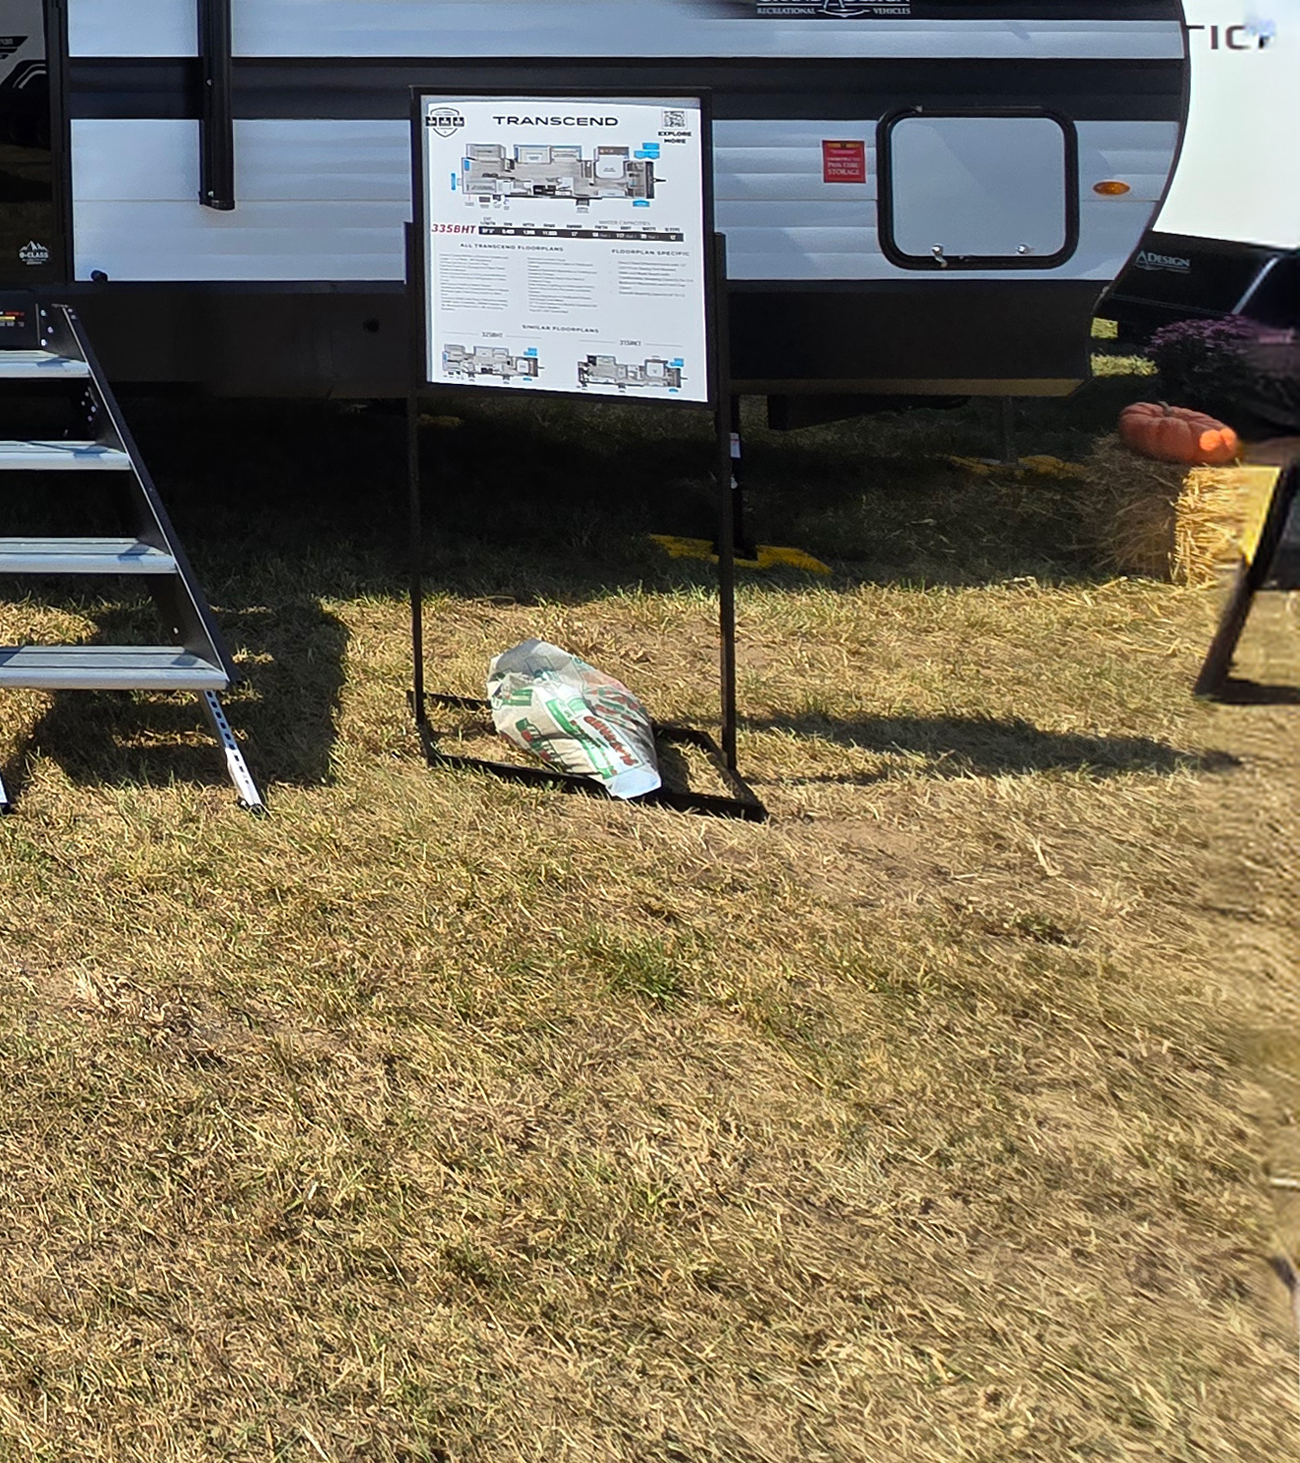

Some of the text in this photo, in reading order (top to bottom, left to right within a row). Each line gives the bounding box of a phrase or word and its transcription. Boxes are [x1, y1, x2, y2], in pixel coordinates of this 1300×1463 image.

[757, 7, 816, 15] RECREATIONAL
[873, 7, 911, 15] VEHICLES
[492, 116, 619, 126] TRANSCEND
[431, 224, 476, 234] 335BHT
[1148, 252, 1190, 267] DESIGN
